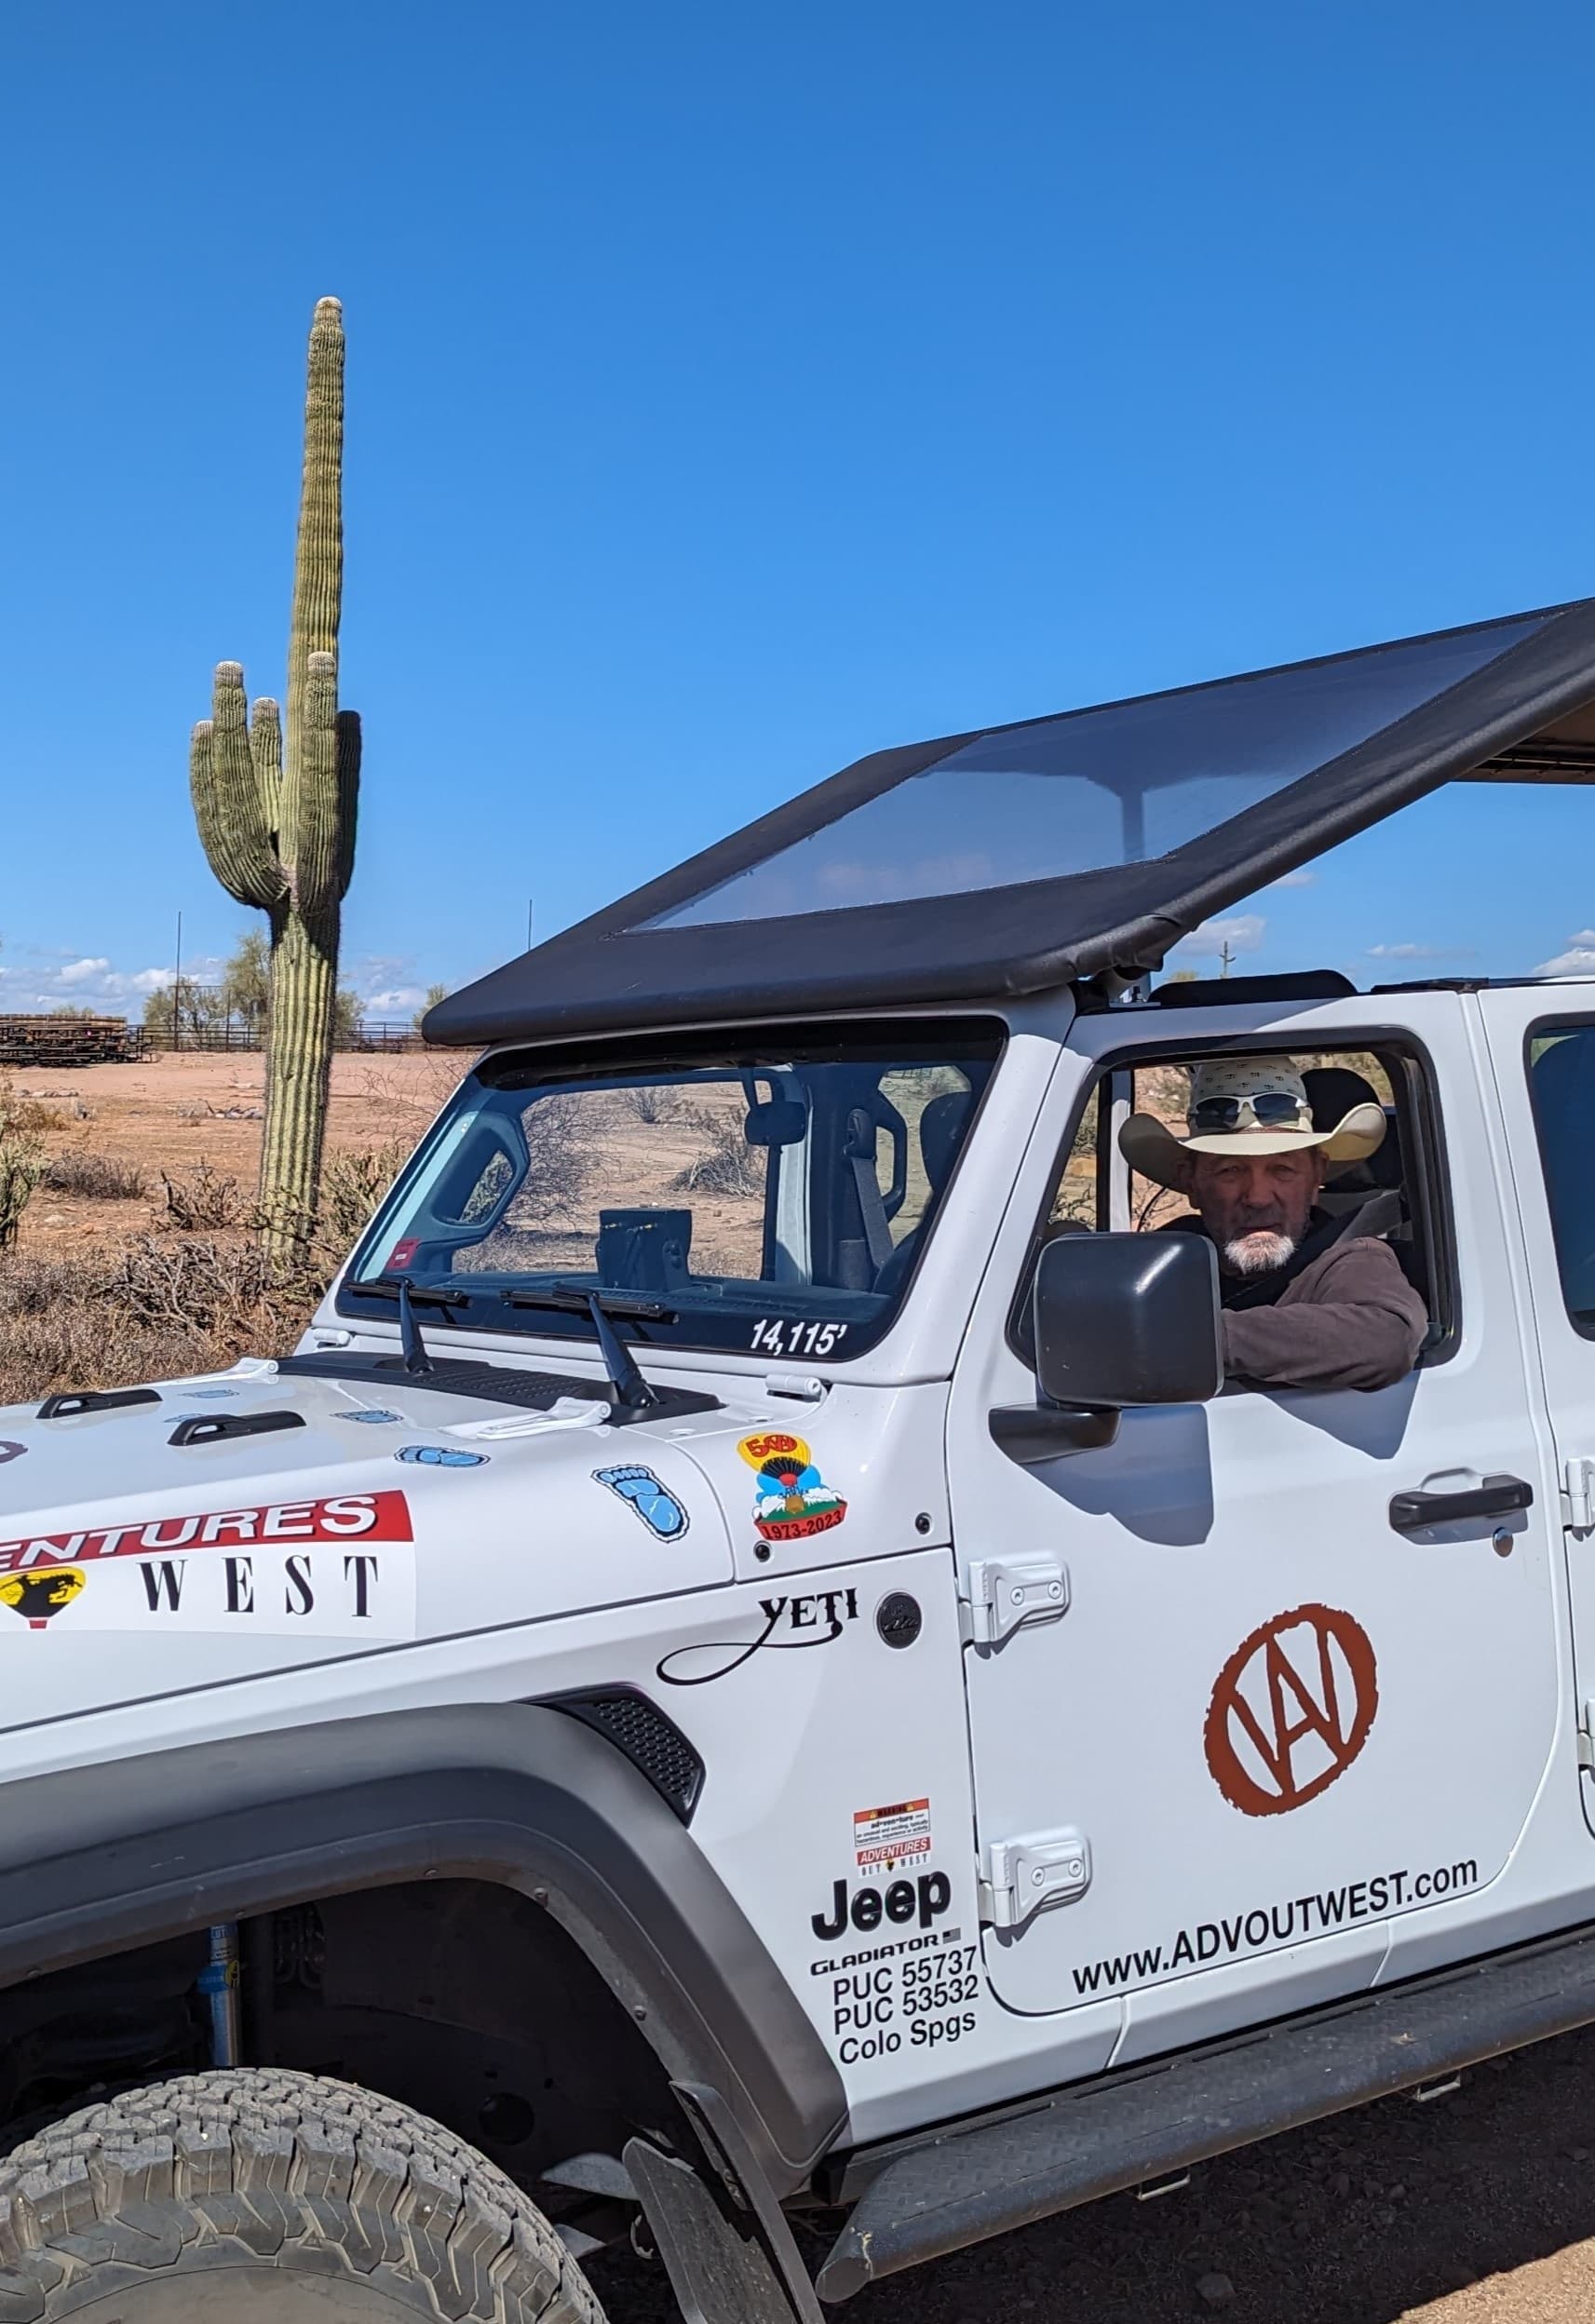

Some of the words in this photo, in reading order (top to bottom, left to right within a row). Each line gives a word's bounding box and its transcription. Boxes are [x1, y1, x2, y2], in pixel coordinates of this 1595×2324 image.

[750, 1318, 847, 1356] 14,115'
[761, 1510, 843, 1541] 1973-2023
[135, 1555, 378, 1617] WEST
[860, 1838, 928, 1863] ADVENTURES
[811, 1871, 952, 1940] Jeep
[1072, 1859, 1479, 1994] www.ADVOUTWEST.com
[810, 1934, 939, 1976] GLADIATOR
[833, 1967, 893, 2006] PUC
[901, 1946, 977, 1987] 55737
[834, 1996, 894, 2035] PUC
[902, 1974, 980, 2016] 53532
[840, 2030, 901, 2064] Colo
[911, 2012, 976, 2047] Spgs
